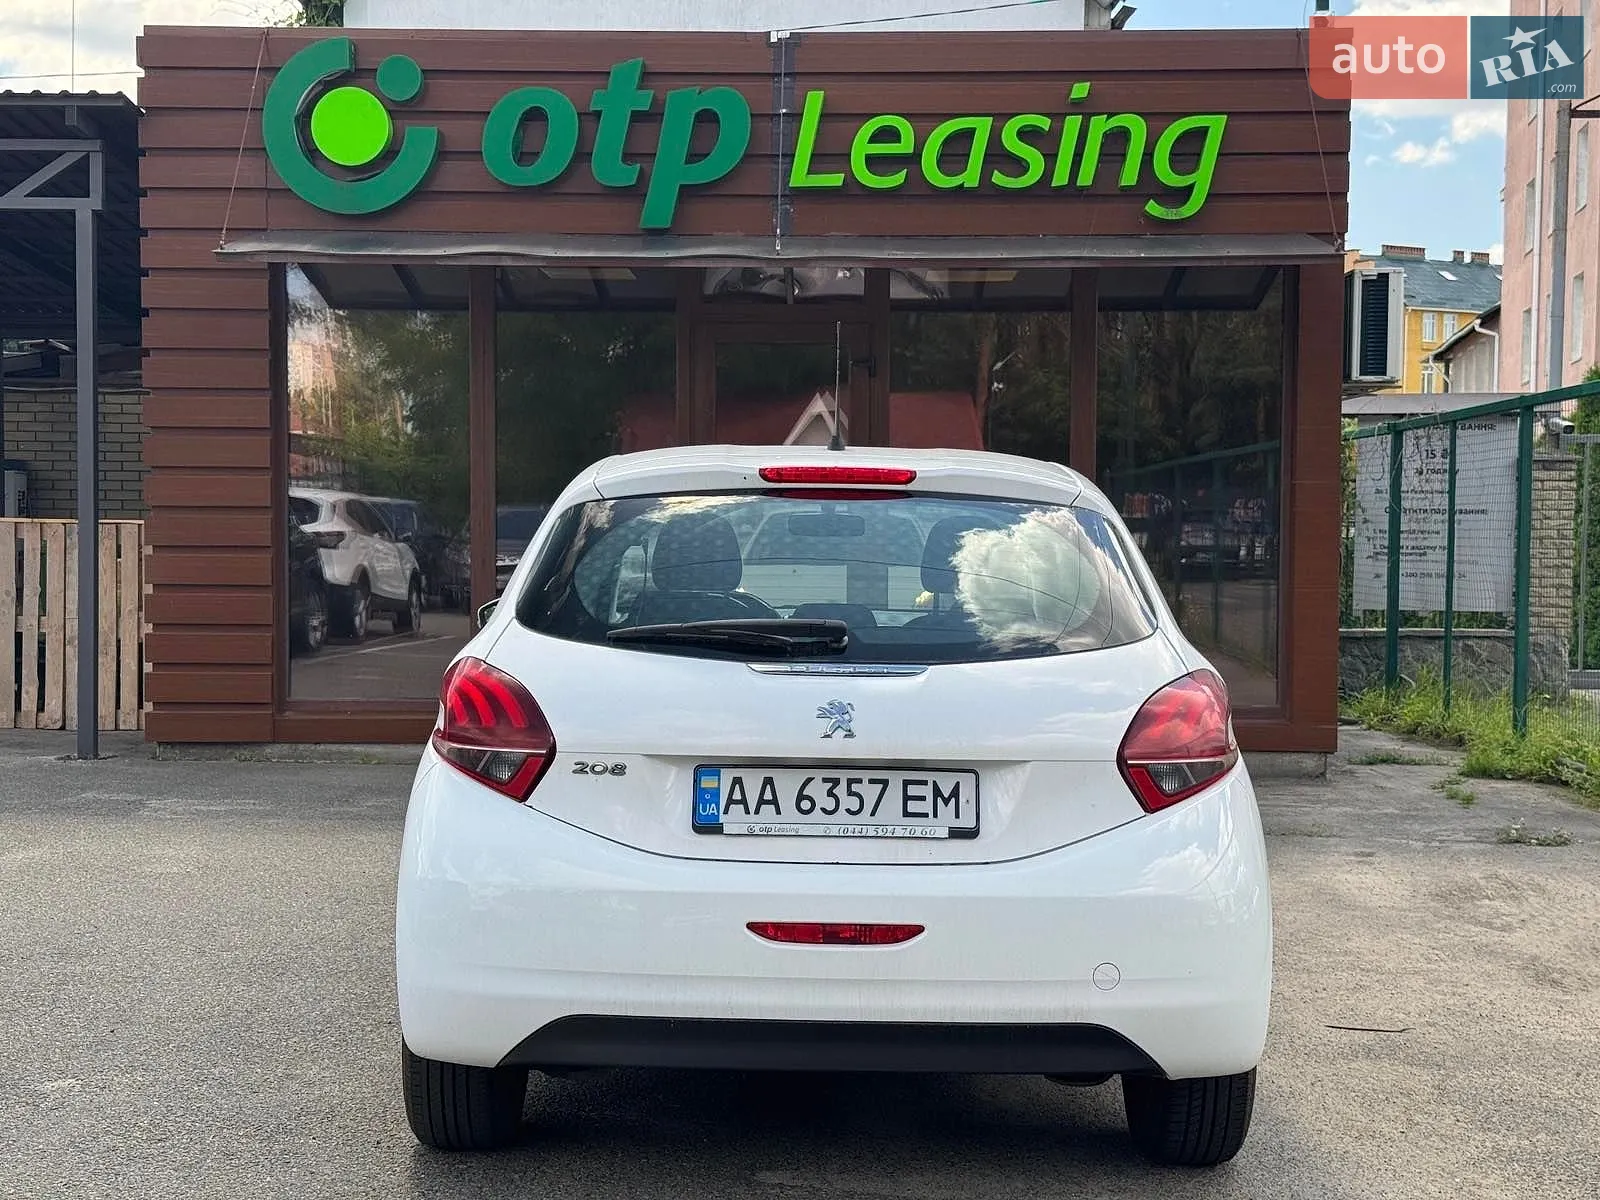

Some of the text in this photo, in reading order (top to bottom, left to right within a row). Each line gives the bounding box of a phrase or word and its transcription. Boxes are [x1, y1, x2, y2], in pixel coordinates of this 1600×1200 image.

[482, 57, 1228, 229] otp Leasing
[572, 761, 627, 776] 208
[723, 776, 960, 819] AA 6357 EM
[699, 803, 718, 816] UA
[759, 825, 800, 834] otp Leasing
[837, 827, 869, 836] (044)
[873, 827, 896, 836] 594
[900, 828, 917, 837] 70
